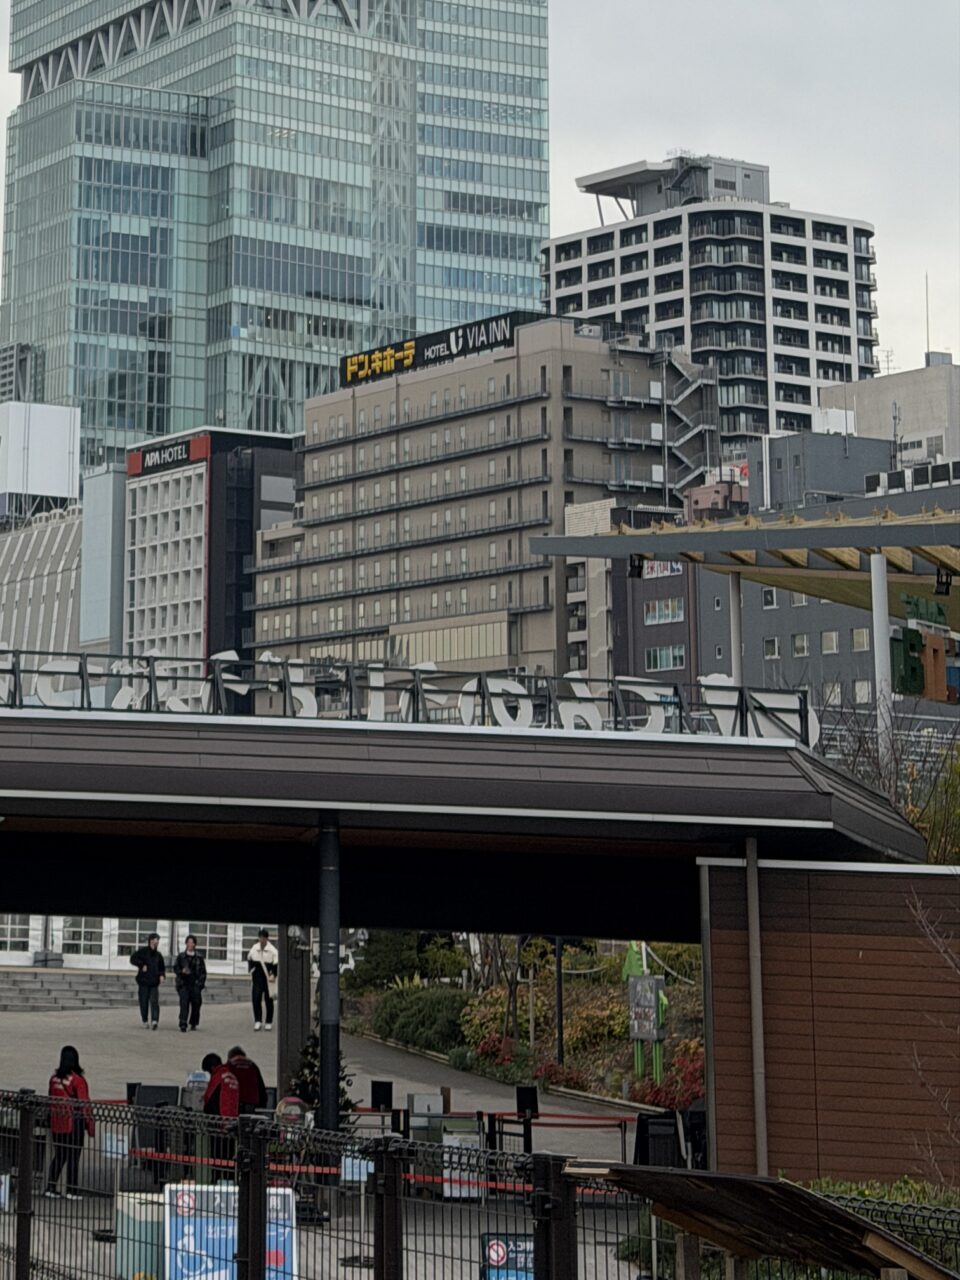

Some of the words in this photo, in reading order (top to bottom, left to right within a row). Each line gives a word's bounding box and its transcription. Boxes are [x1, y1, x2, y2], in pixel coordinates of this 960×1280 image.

[424, 342, 450, 361] HOTEL
[466, 324, 488, 350] VIA
[489, 317, 511, 344] INN
[144, 449, 160, 468] APA
[161, 444, 188, 464] HOTEL
